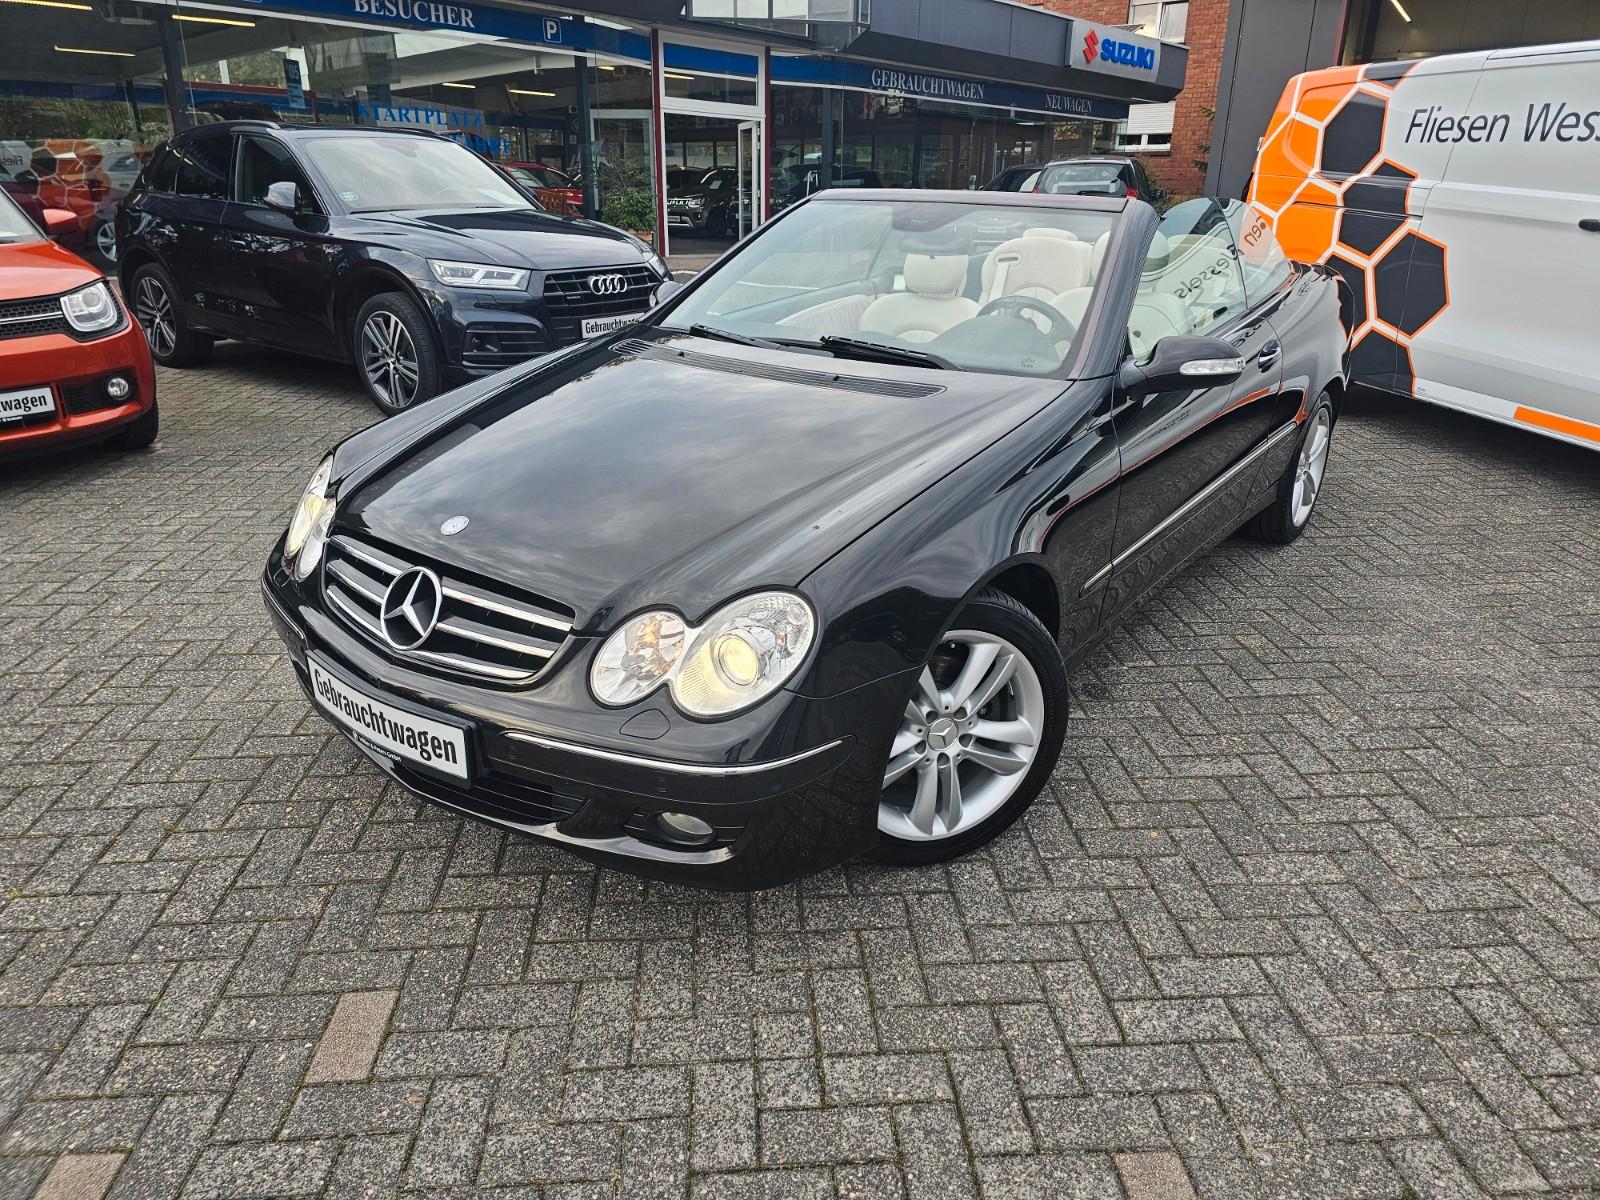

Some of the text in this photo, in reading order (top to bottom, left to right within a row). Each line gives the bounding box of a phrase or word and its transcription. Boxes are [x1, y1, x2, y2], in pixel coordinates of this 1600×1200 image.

[353, 0, 475, 29] BESUCHER
[546, 20, 558, 40] P
[1100, 38, 1155, 70] SUZUKI
[871, 68, 985, 100] GEBRAUCHTWAGEN
[1044, 94, 1093, 113] NEUWAGEN
[1404, 102, 1600, 144] Fliesen Wes
[0, 394, 48, 413] wagen
[313, 668, 458, 765] Gebrauchtwagen
